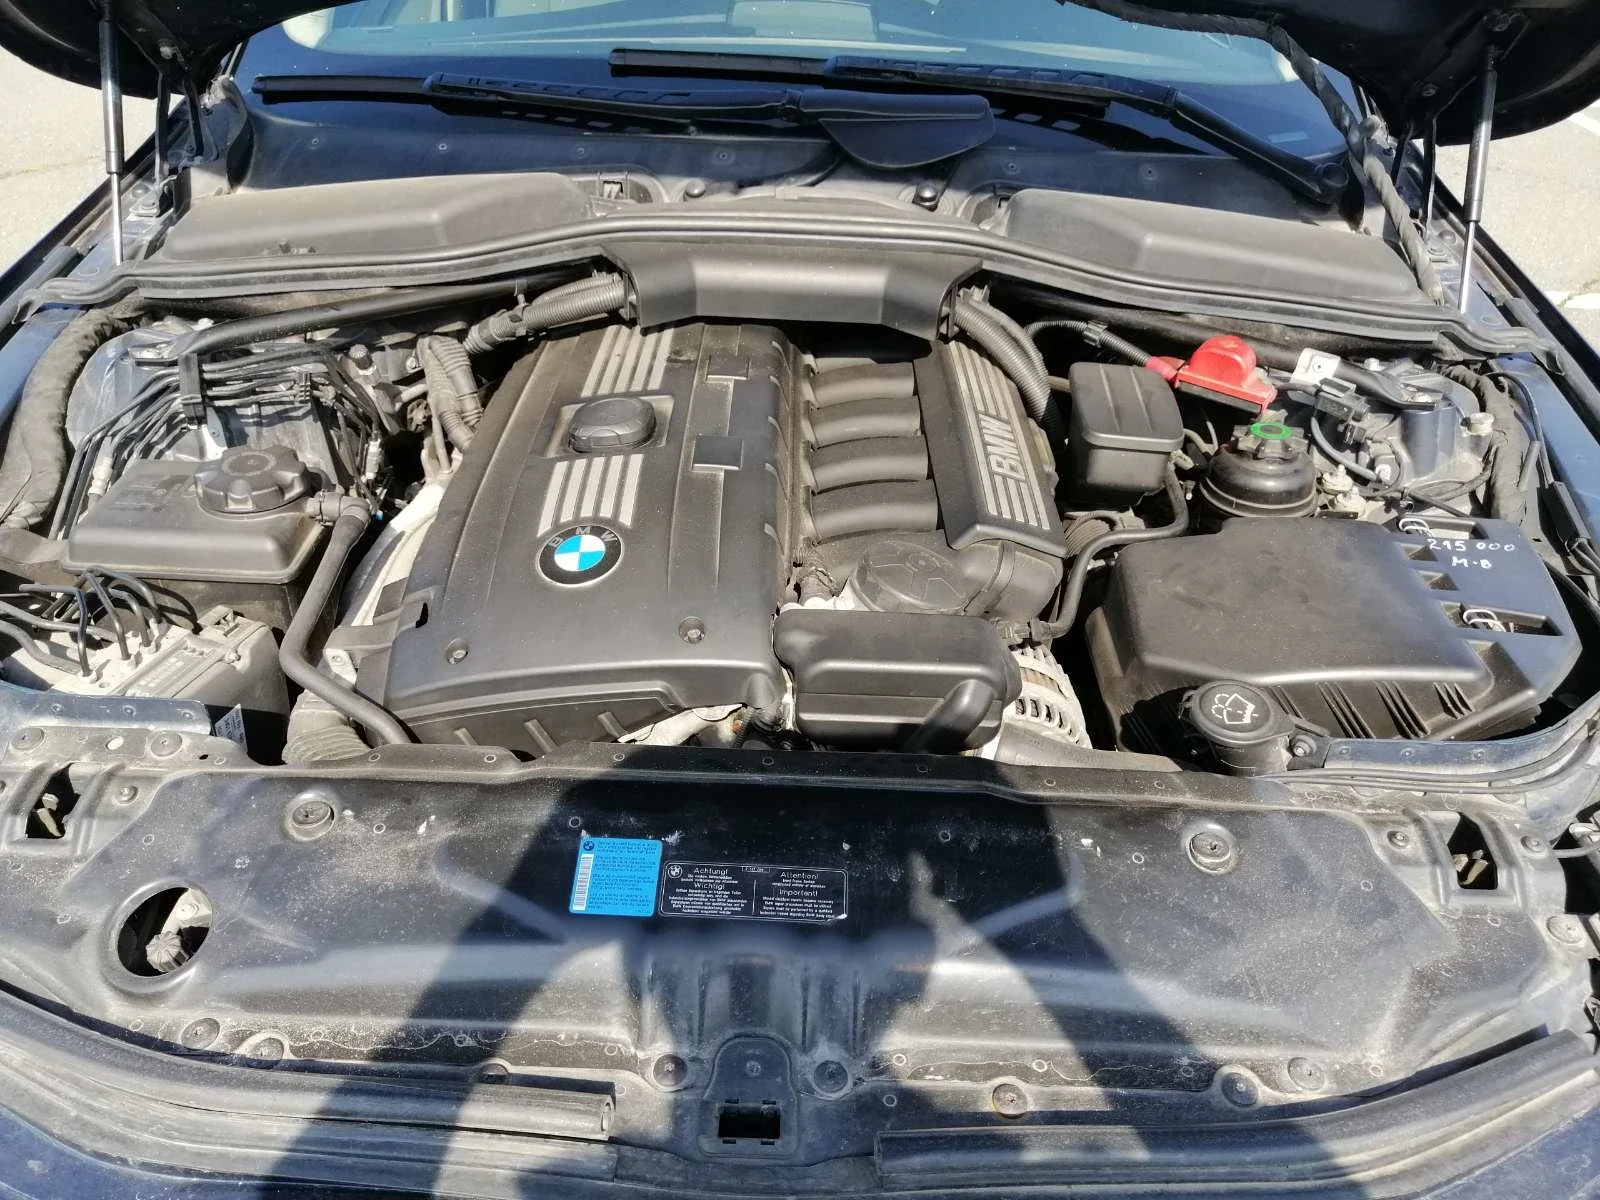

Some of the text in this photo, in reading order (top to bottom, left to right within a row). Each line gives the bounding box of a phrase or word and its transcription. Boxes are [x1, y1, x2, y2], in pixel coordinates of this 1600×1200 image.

[978, 413, 1026, 482] BMW
[548, 526, 618, 548] BMW
[1475, 541, 1517, 552] 000
[693, 867, 728, 876] Achtung!
[780, 871, 819, 880] Attention!
[693, 882, 725, 890] Wichtig!
[779, 888, 818, 897] Important!
